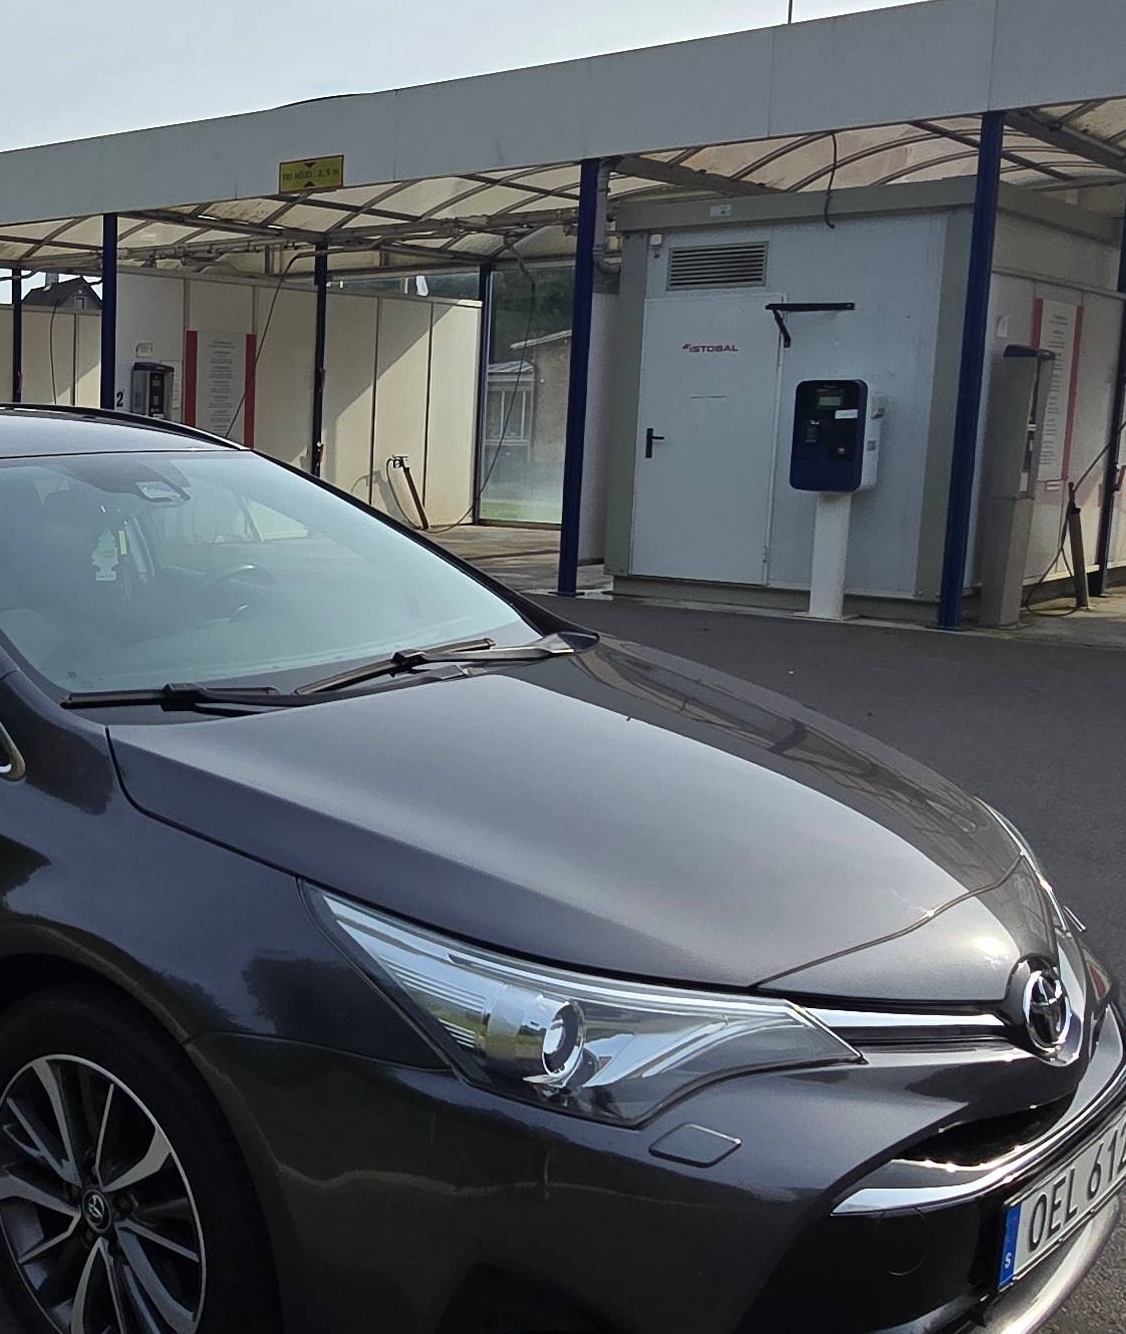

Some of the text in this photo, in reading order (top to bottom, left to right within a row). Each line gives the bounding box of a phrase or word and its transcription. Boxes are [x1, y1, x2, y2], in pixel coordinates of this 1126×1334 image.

[317, 168, 331, 178] 2,5
[689, 344, 738, 353] ISTOBAL
[116, 391, 124, 408] 2
[1029, 1168, 1078, 1252] OEL
[1004, 1252, 1012, 1270] S
